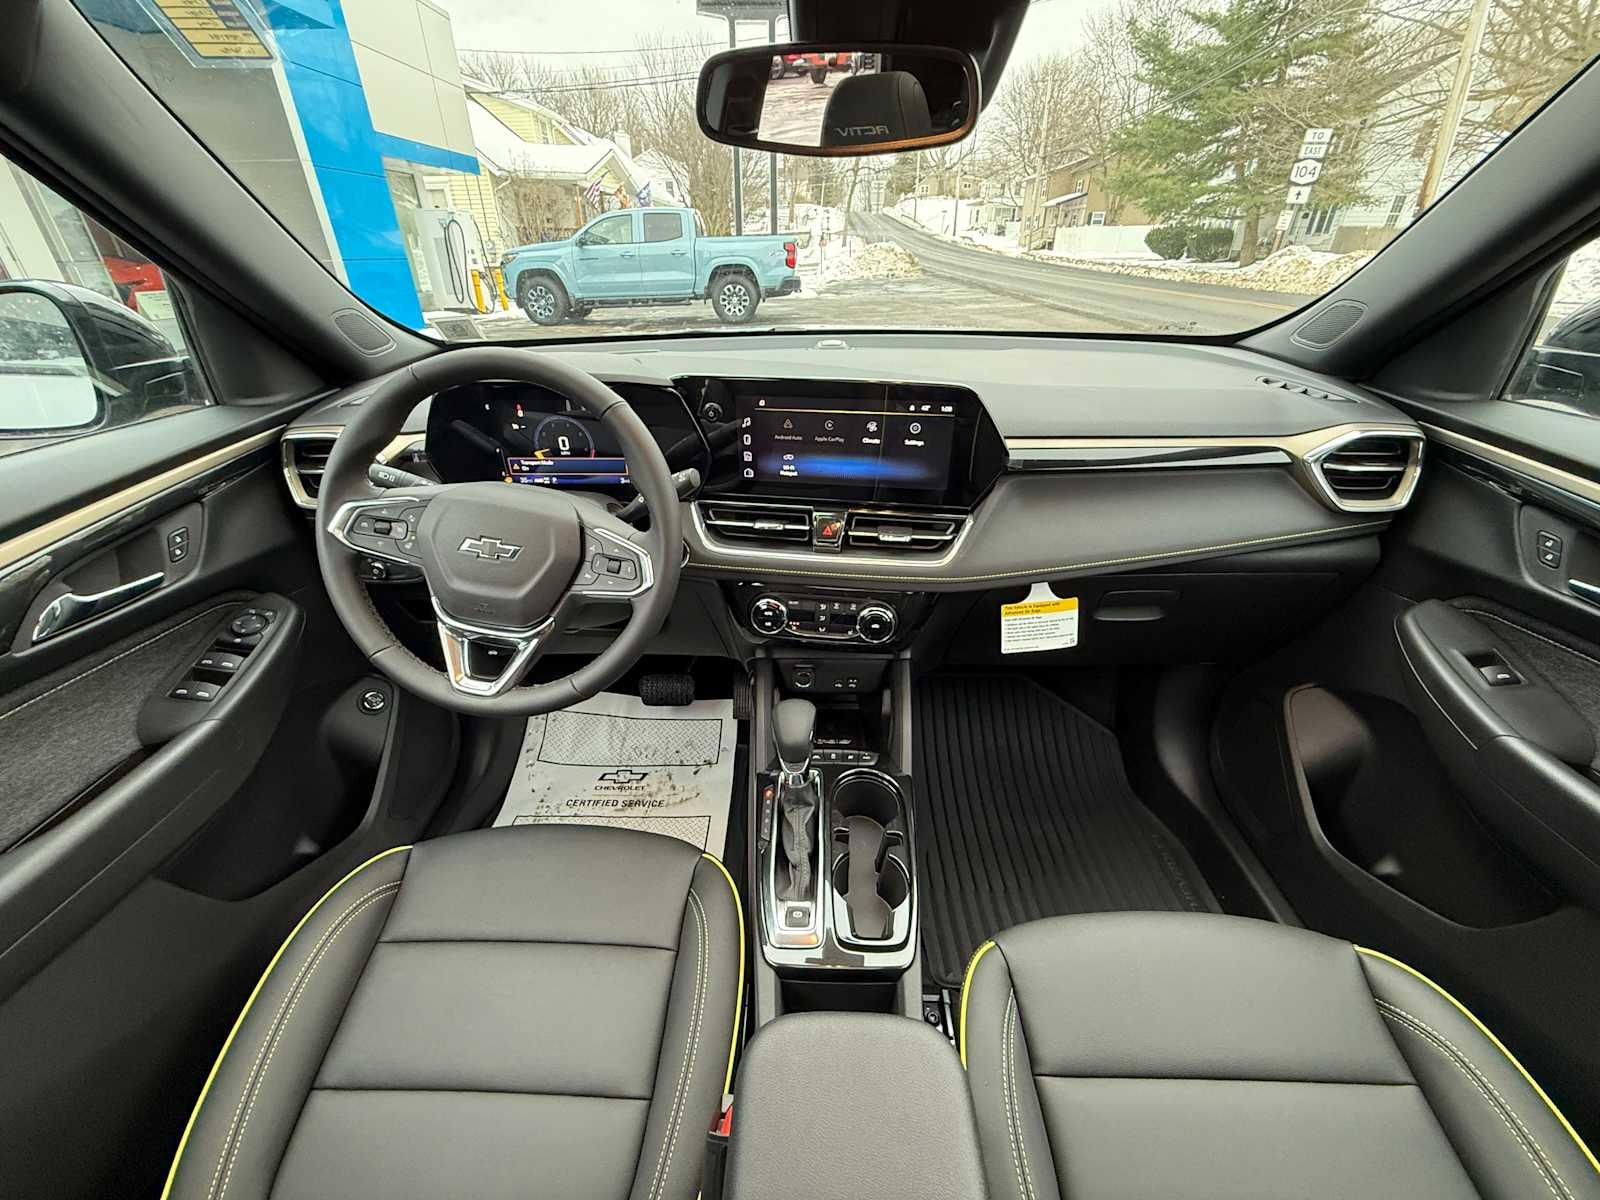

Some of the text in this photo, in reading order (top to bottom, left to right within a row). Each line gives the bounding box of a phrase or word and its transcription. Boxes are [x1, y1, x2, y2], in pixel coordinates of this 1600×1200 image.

[1312, 131, 1324, 139] TO
[1304, 147, 1322, 155] EAST
[1294, 165, 1317, 178] 104
[558, 436, 570, 451] 0
[828, 436, 845, 444] CarPlay
[566, 799, 665, 808] CERTIFIED SERVICE
